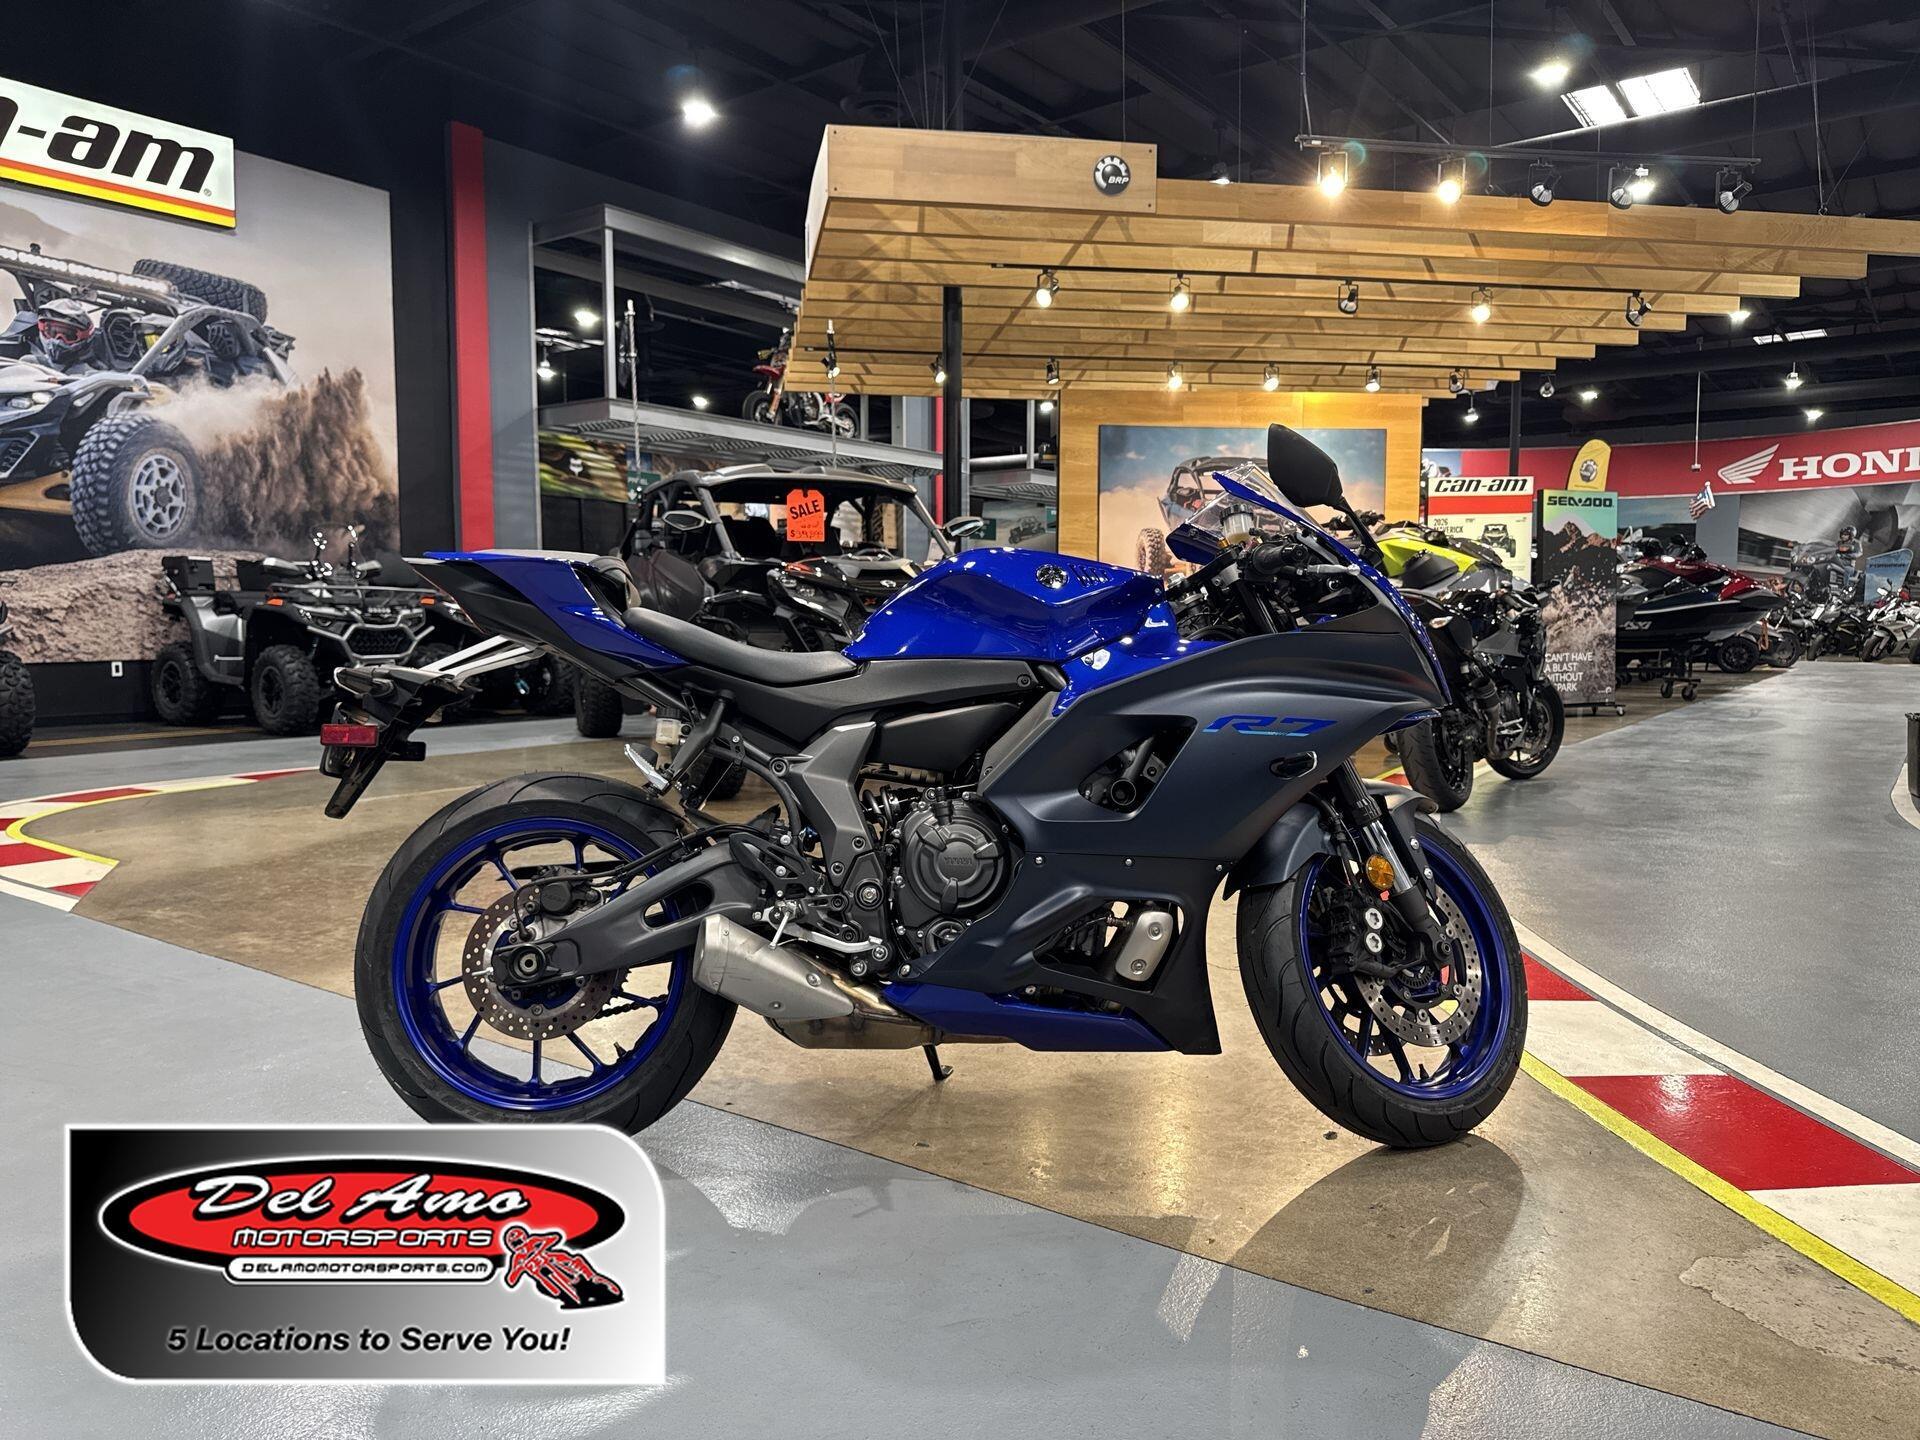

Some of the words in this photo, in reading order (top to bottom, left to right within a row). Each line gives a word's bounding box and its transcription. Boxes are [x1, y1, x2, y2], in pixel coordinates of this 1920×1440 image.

[0, 96, 214, 193] -am
[1108, 175, 1129, 184] BRP
[790, 499, 821, 520] SALE
[1571, 652, 1593, 661] HAVE
[1552, 662, 1578, 672] BLAST
[1554, 683, 1577, 691] PARK
[1203, 713, 1338, 737] R7
